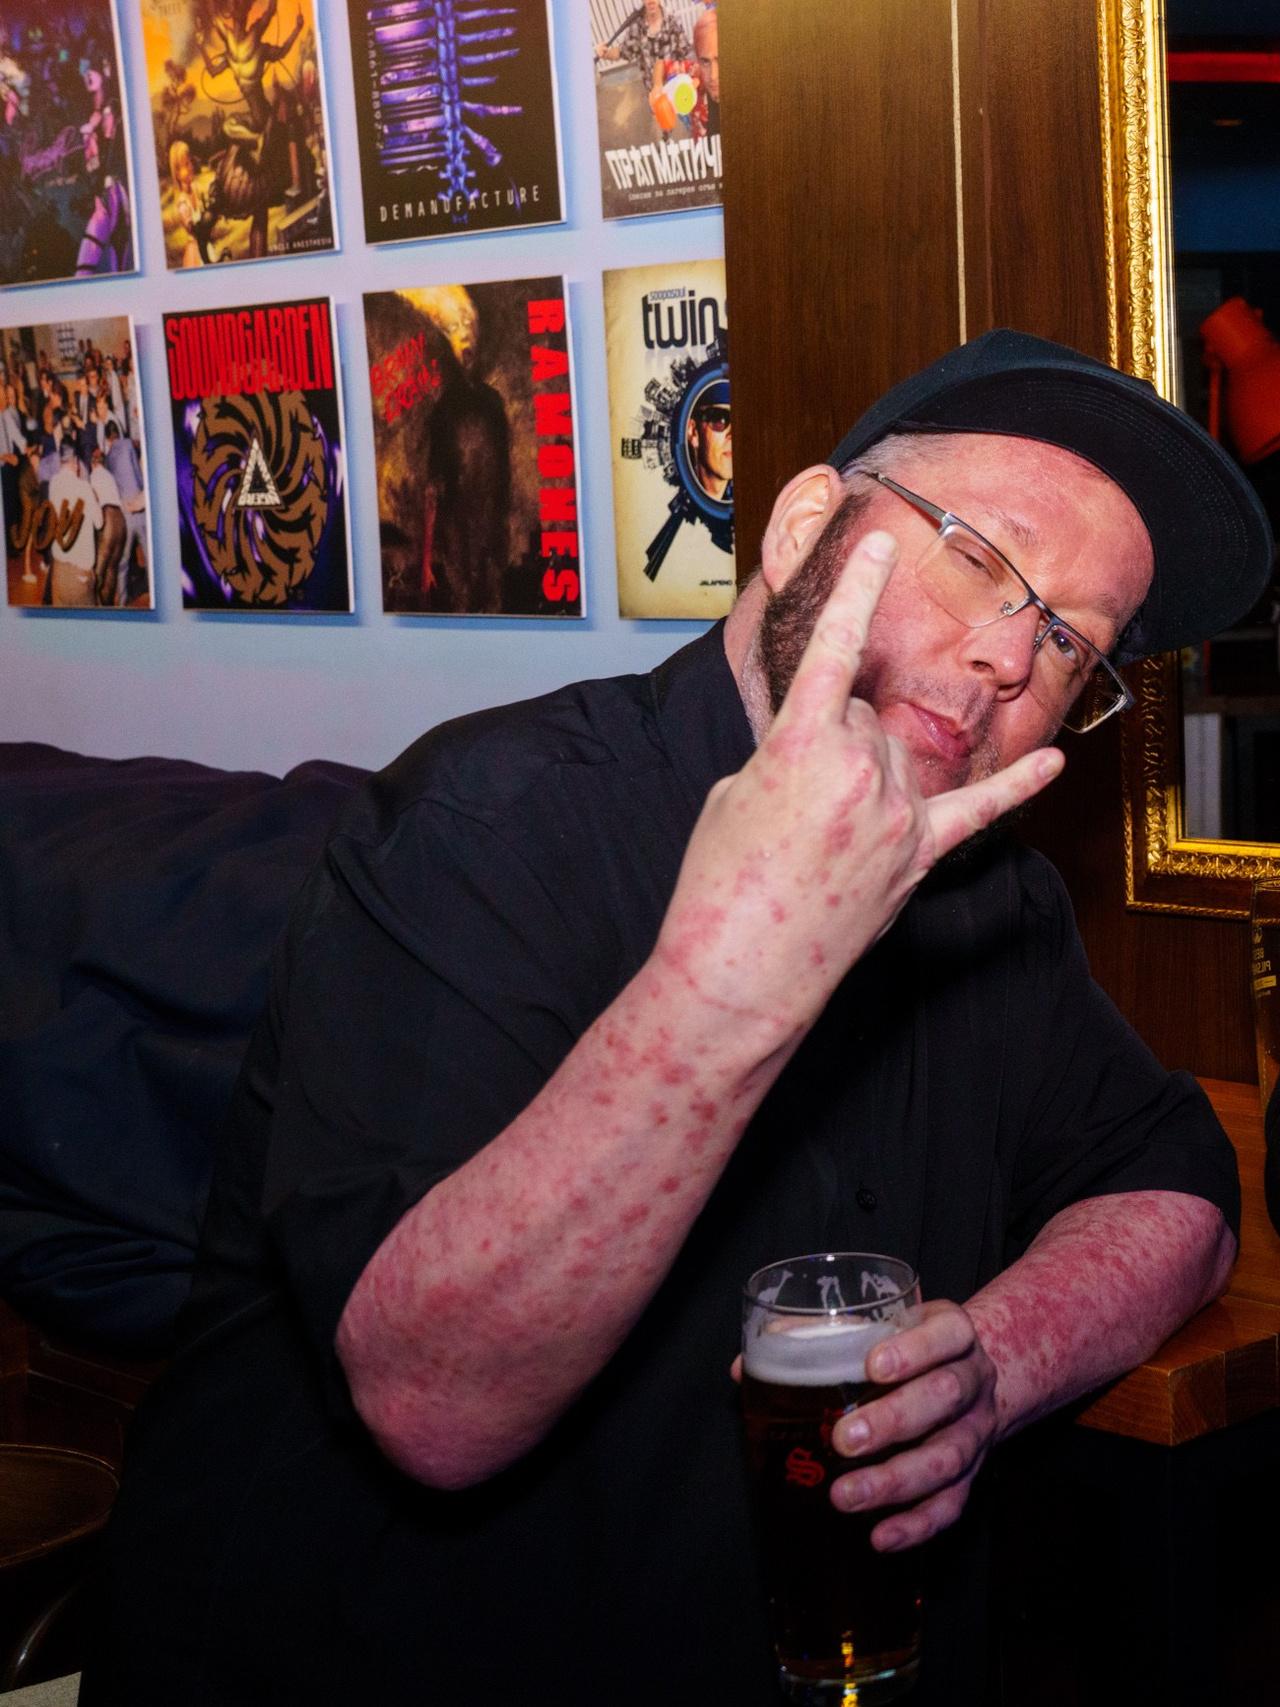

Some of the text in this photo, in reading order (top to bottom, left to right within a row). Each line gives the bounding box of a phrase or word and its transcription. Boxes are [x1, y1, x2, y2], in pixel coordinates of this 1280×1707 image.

[379, 185, 540, 222] DEMANUFACTURE
[165, 303, 333, 400] SOUNDGARDEN
[641, 289, 720, 350] twin
[527, 299, 580, 603] RAMONES
